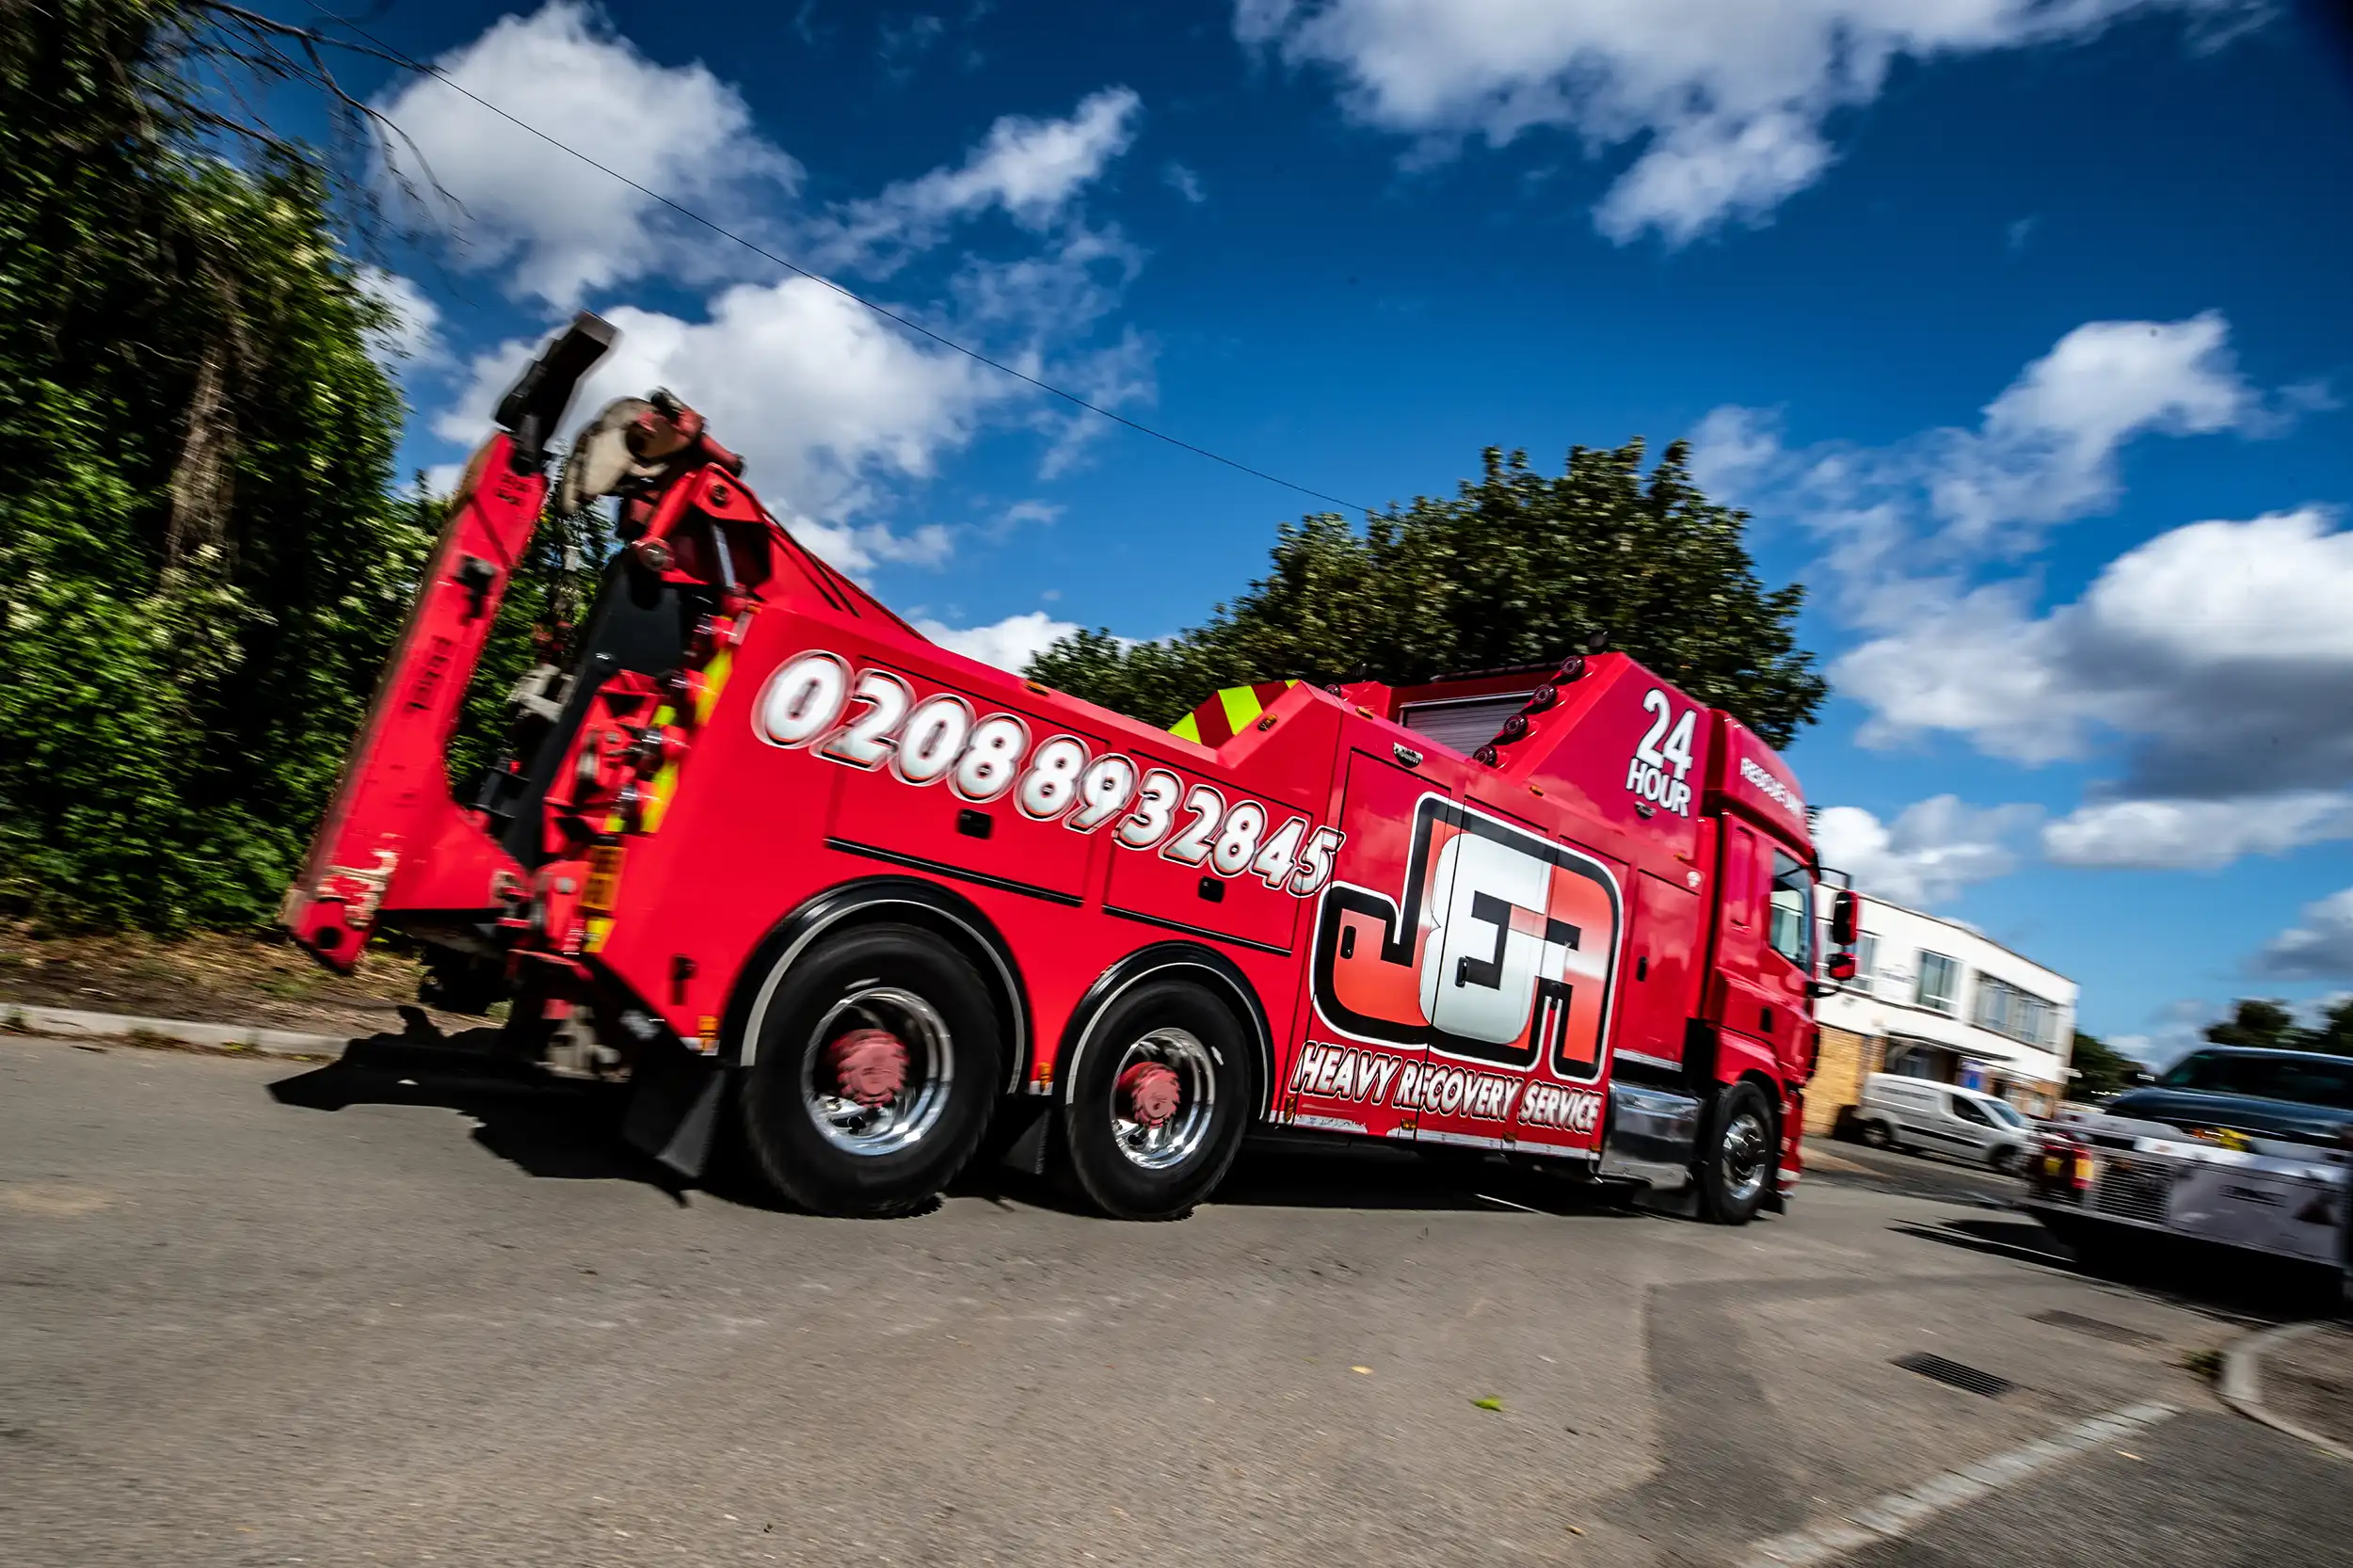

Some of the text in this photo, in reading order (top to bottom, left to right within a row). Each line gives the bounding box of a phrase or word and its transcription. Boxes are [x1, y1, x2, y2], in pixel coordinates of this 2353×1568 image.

[1636, 688, 1697, 780] 24
[1626, 758, 1692, 818] HOUR
[1289, 1041, 1603, 1134] HEAVY RECOVERY SERVICE
